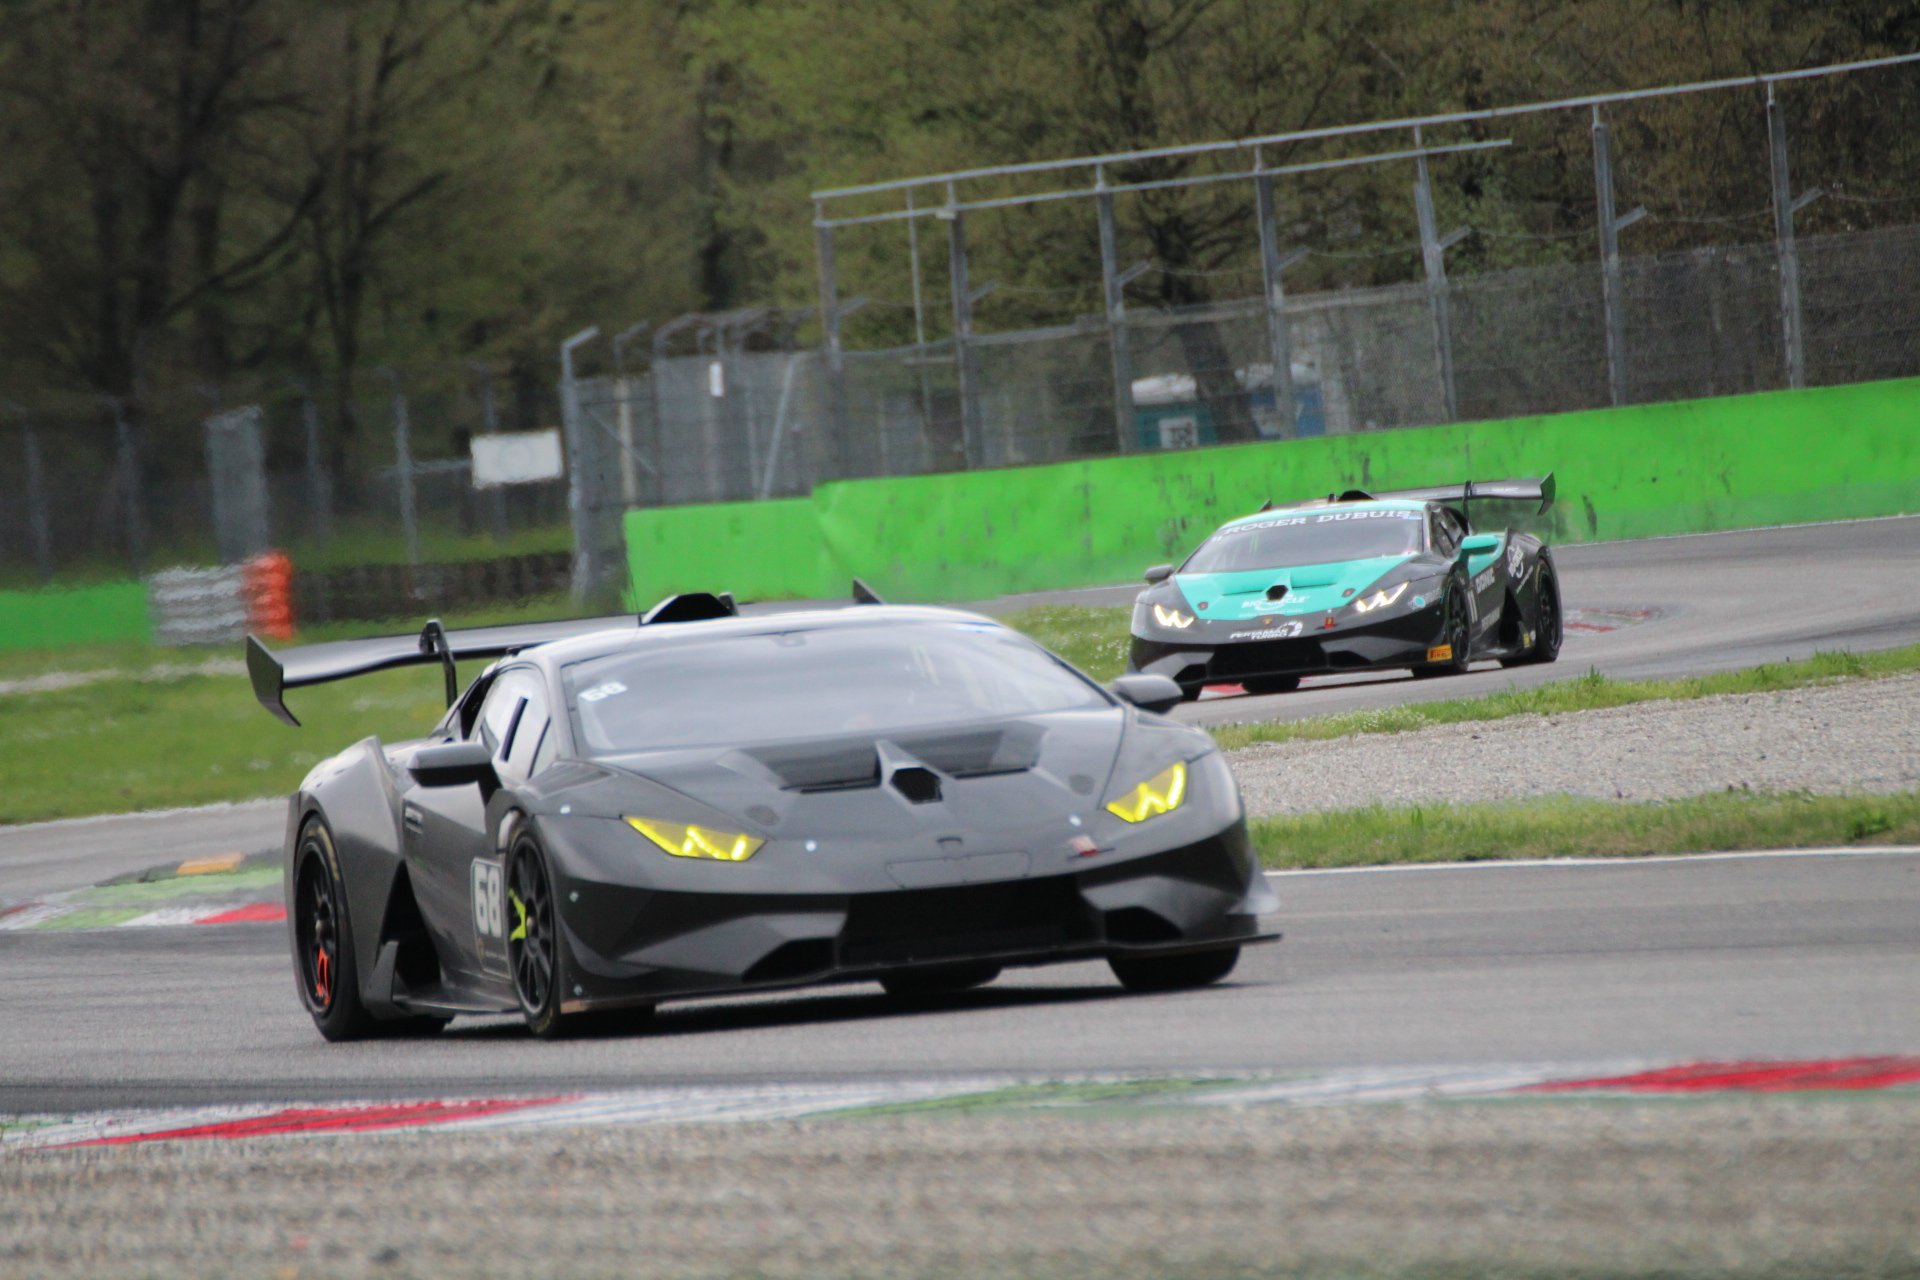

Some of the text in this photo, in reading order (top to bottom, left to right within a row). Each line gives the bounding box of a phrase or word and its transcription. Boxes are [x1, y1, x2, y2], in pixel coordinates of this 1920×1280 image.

[1223, 510, 1412, 535] ROGER DUBUIS
[474, 863, 502, 938] 68
